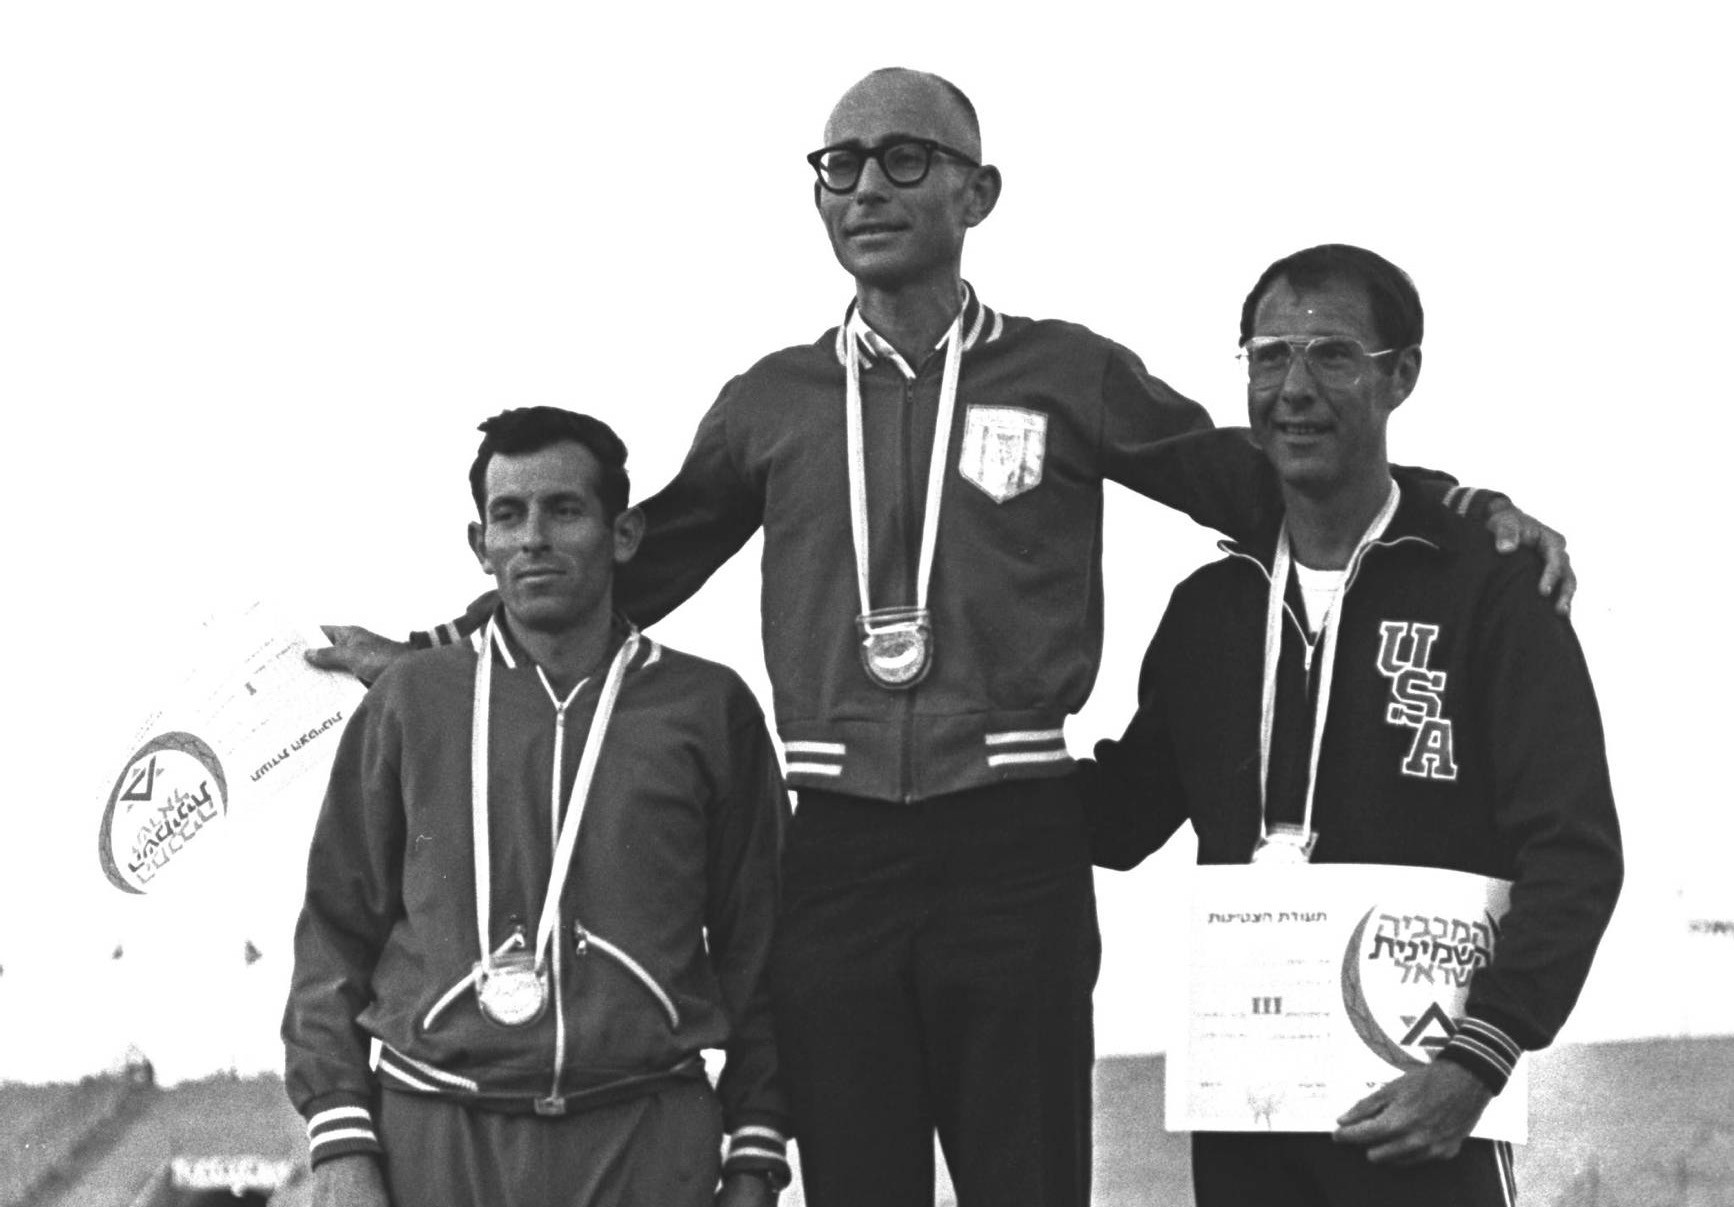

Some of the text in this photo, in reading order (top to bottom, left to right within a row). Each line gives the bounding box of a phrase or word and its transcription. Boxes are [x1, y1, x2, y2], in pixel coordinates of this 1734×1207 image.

[1377, 620, 1458, 780] USA
[1379, 914, 1491, 950] המכביה
[1368, 934, 1492, 967] השמינית
[1394, 958, 1474, 988] שראל
[1252, 996, 1283, 1015] III
